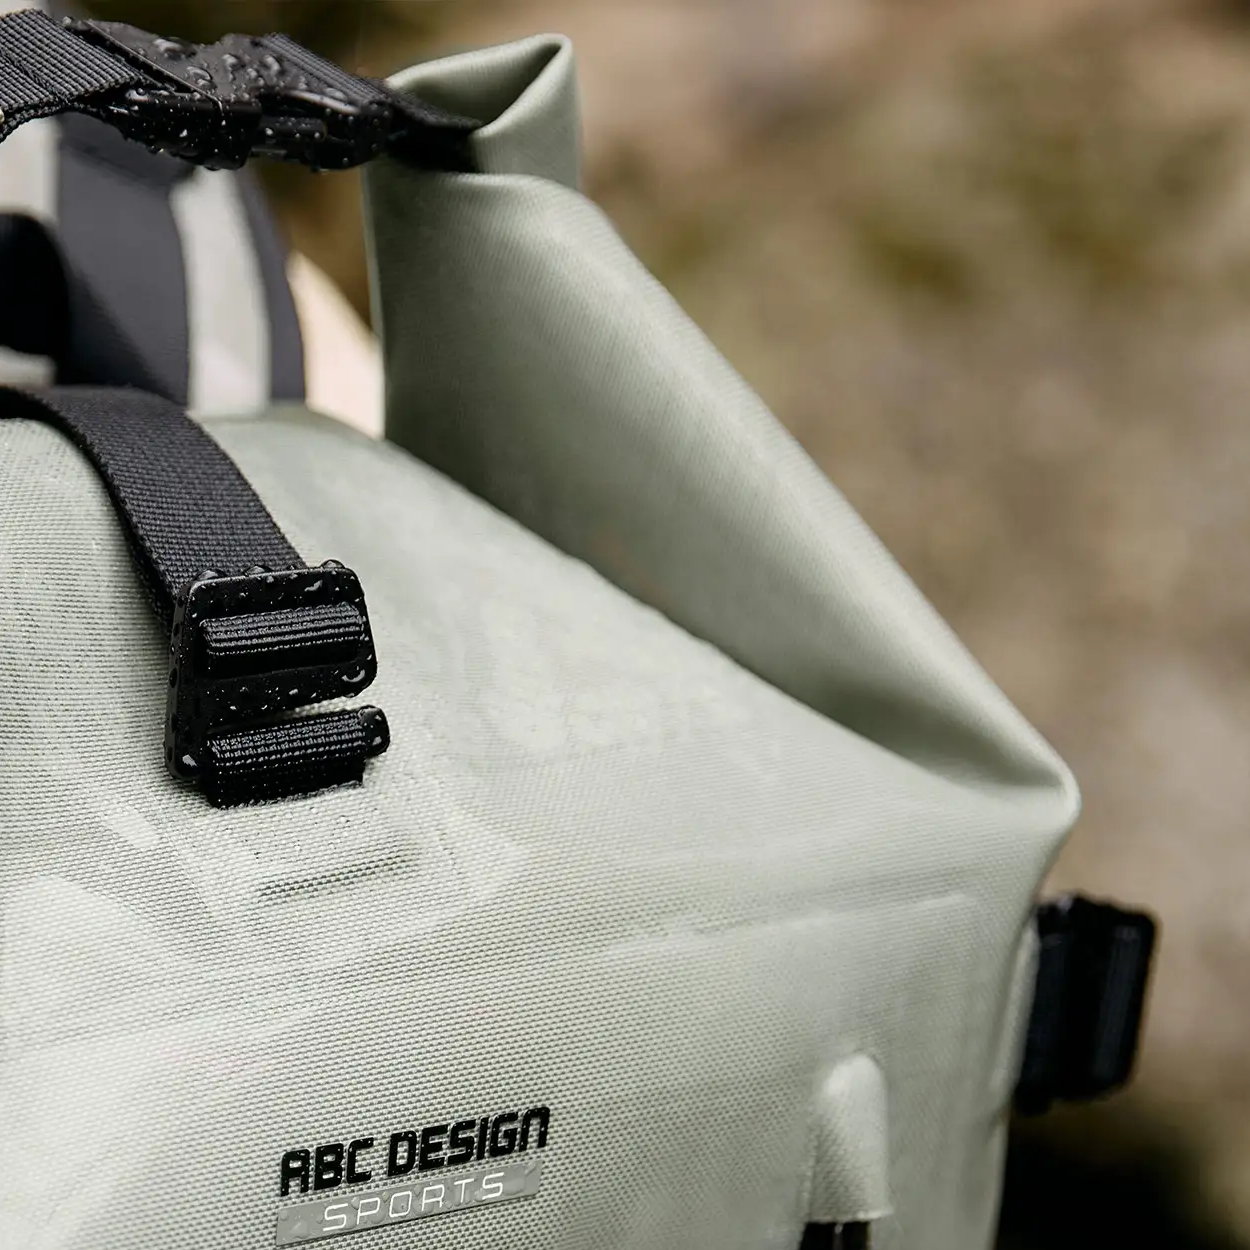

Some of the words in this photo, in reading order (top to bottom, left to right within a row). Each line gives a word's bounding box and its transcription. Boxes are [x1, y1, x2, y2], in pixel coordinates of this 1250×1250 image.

[281, 1136, 374, 1196] ABC
[387, 1106, 550, 1176] DESIGN
[322, 1172, 505, 1232] SPORTS
